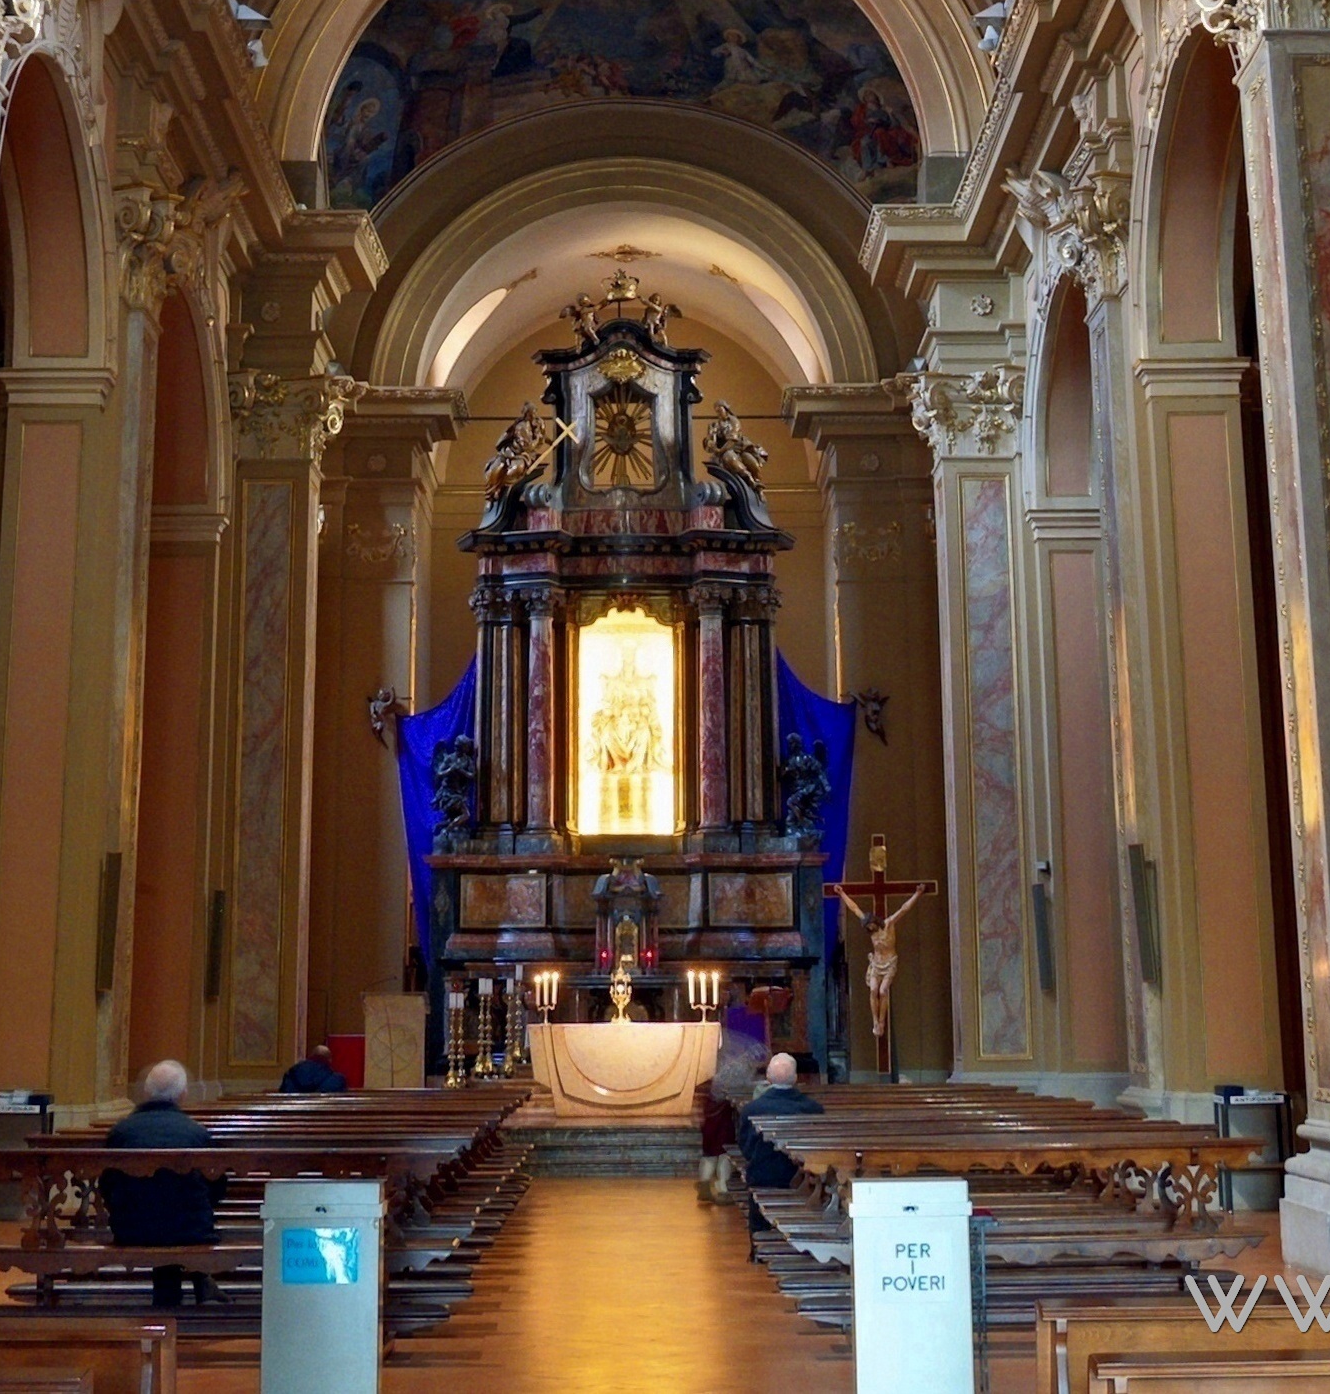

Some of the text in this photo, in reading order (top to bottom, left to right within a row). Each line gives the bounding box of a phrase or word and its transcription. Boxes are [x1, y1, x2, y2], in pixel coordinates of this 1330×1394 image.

[895, 1242, 932, 1259] PER
[910, 1259, 915, 1276] I
[882, 1275, 946, 1293] POVERI
